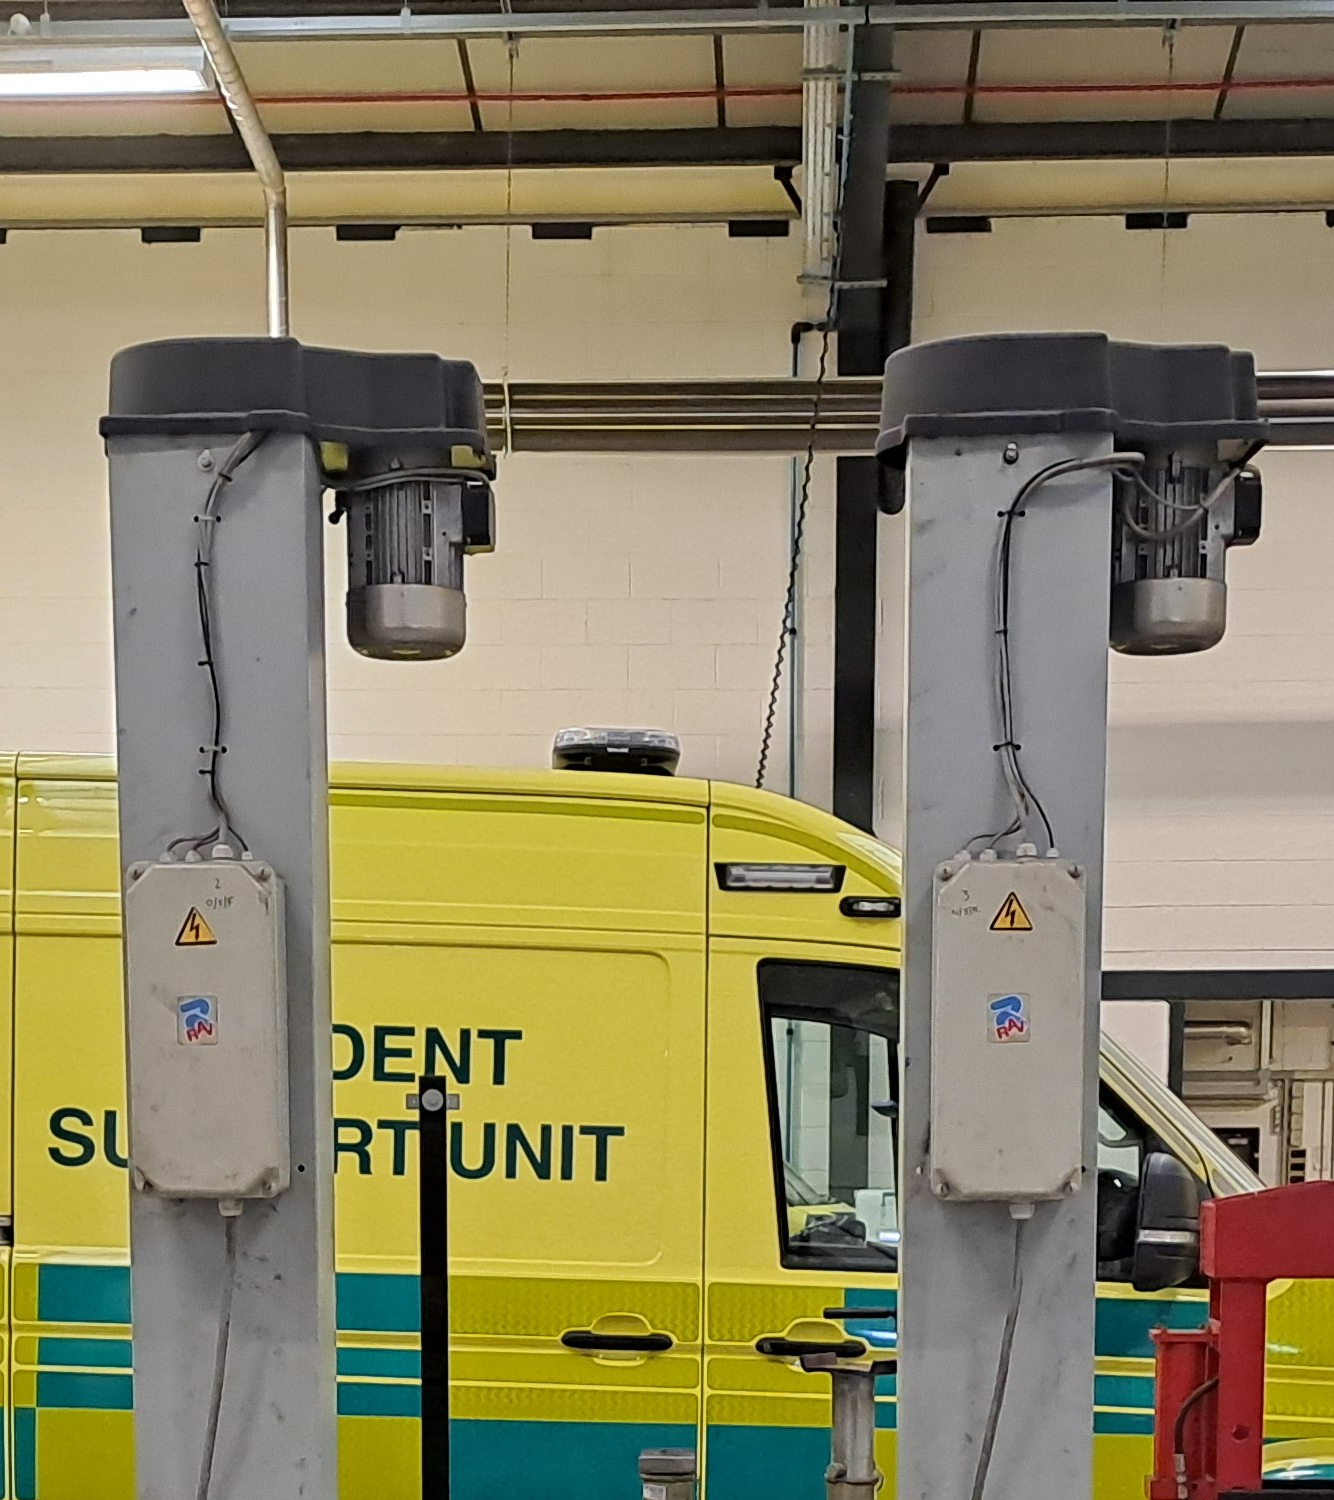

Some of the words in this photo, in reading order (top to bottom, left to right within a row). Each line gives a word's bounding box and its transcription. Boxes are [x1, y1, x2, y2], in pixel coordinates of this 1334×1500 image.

[186, 1020, 214, 1042] RAV
[996, 1018, 1025, 1040] RAV
[332, 1023, 523, 1086] DENT
[450, 1121, 625, 1182] UNIT
